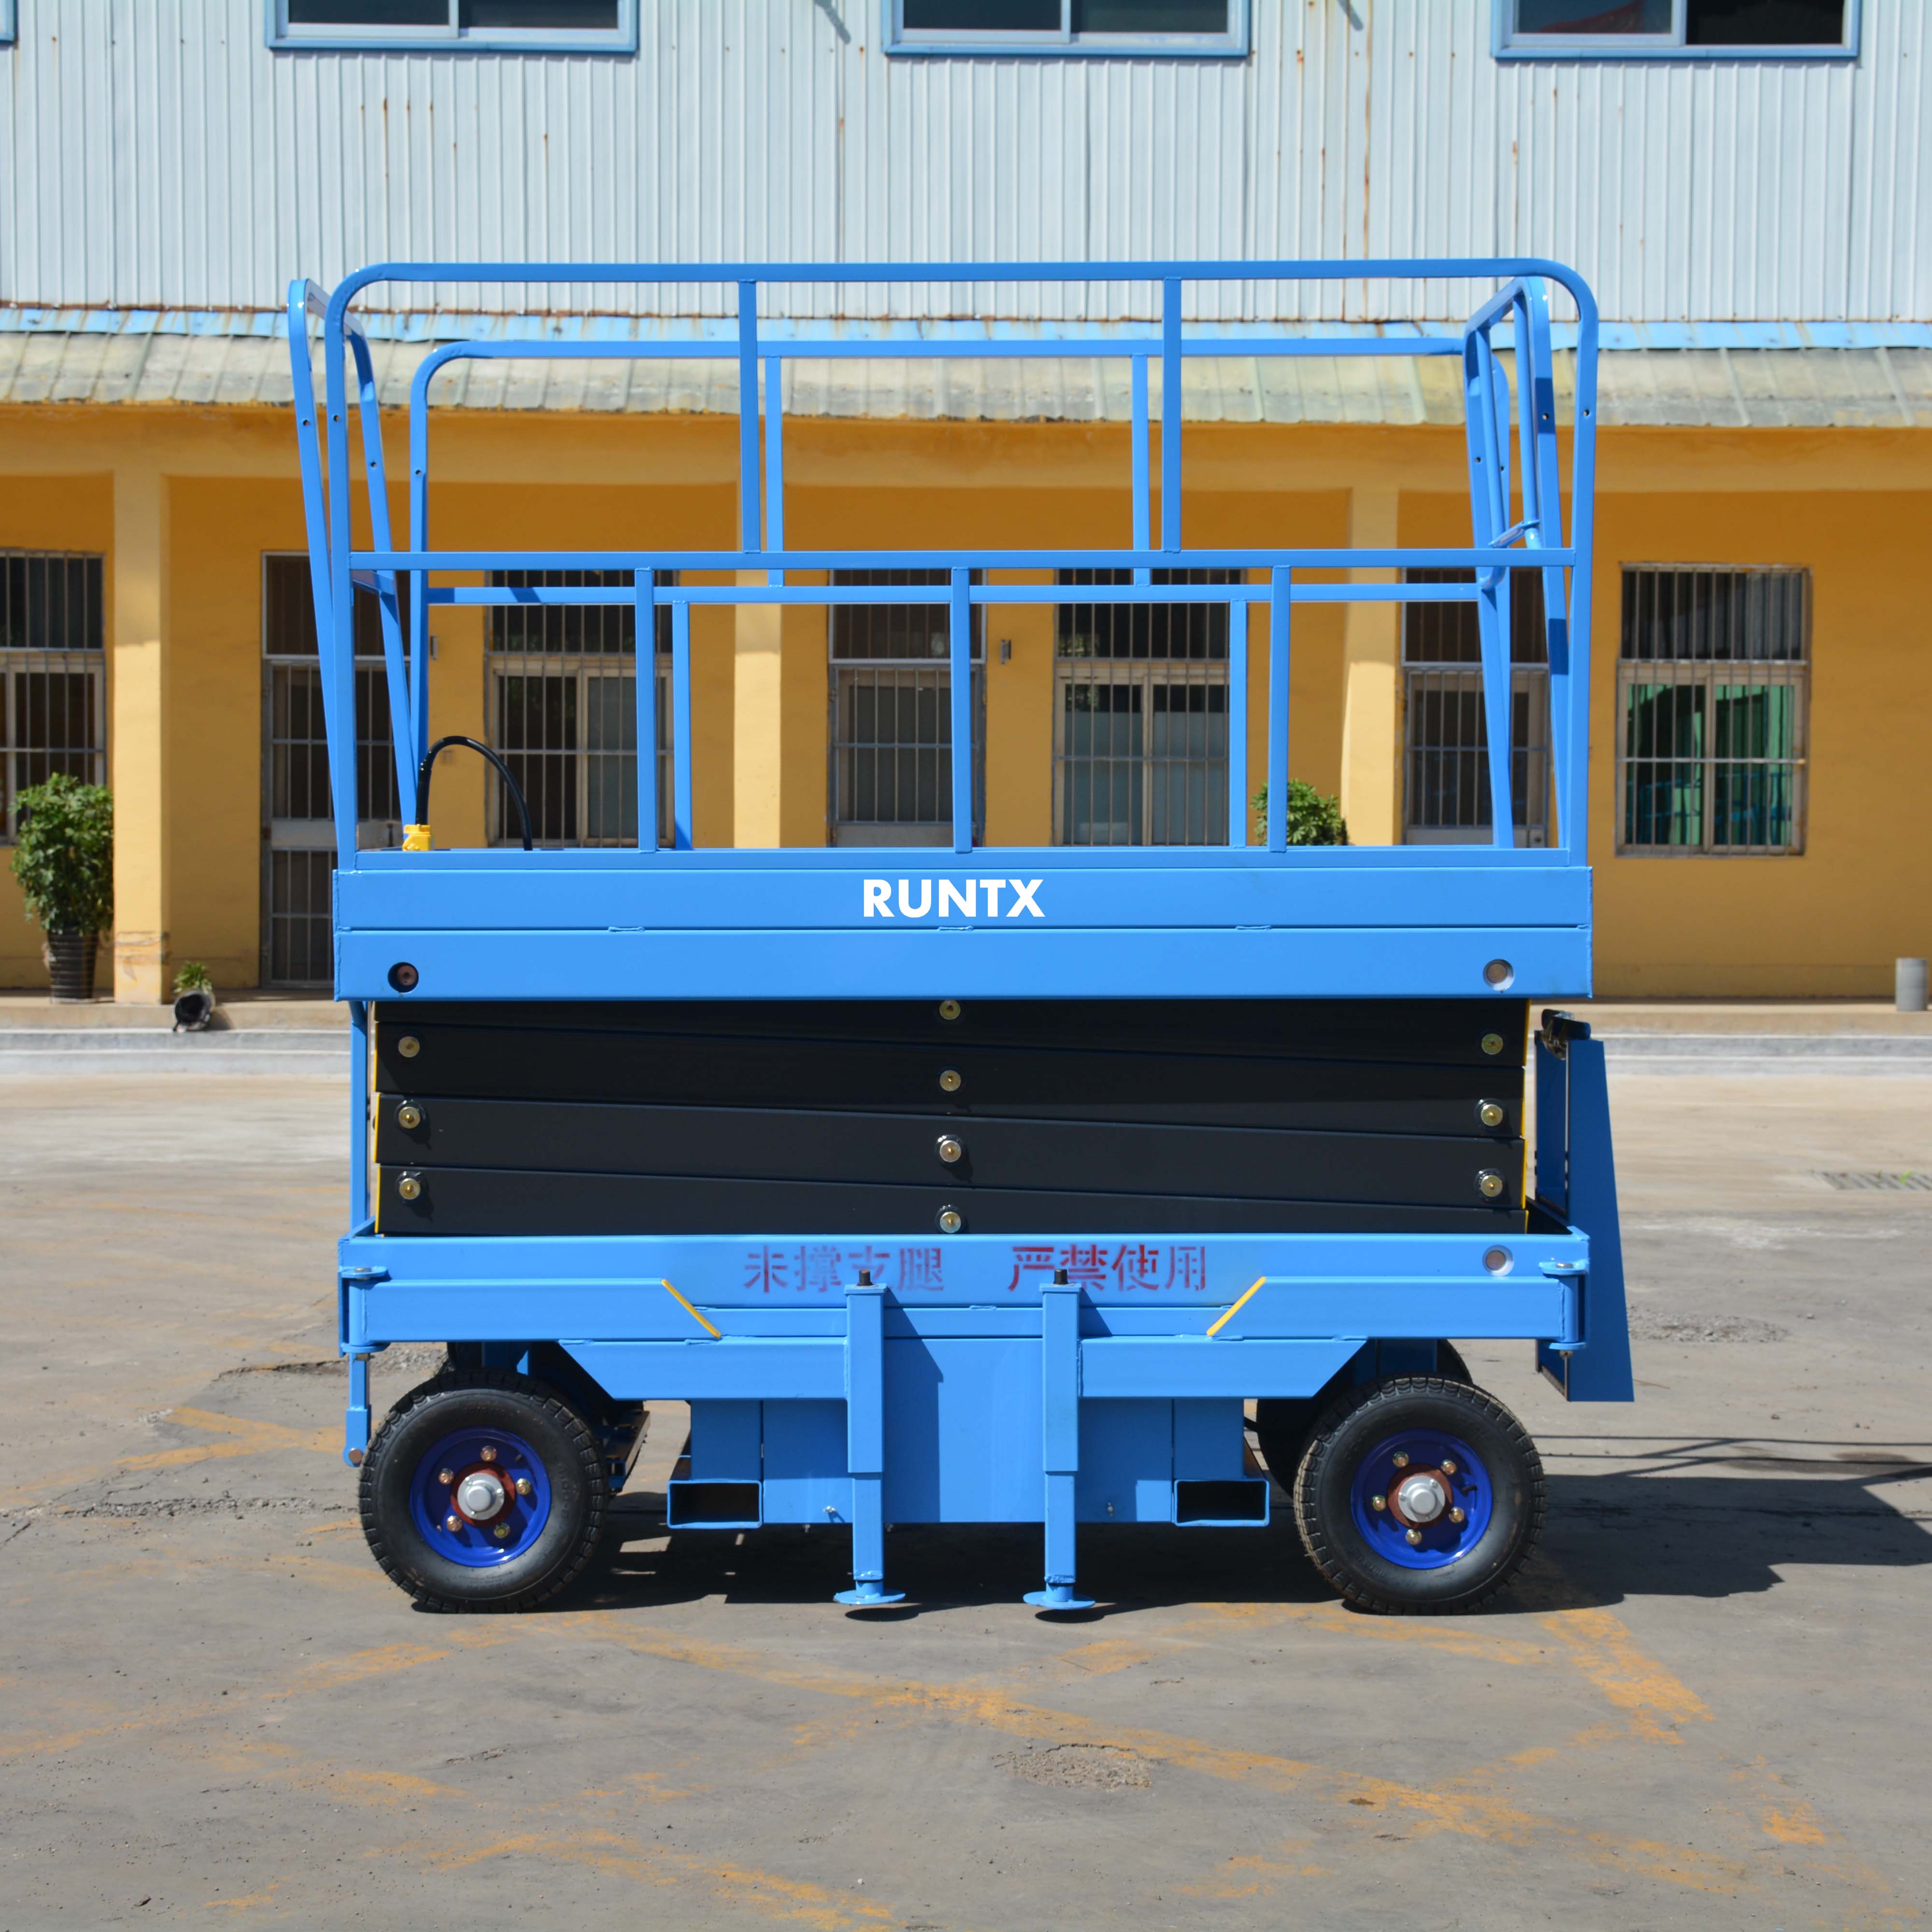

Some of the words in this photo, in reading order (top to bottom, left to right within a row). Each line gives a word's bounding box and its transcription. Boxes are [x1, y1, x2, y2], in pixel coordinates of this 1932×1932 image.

[864, 879, 1045, 918] RUNTX
[1008, 1244, 1206, 1291] 严禁使用
